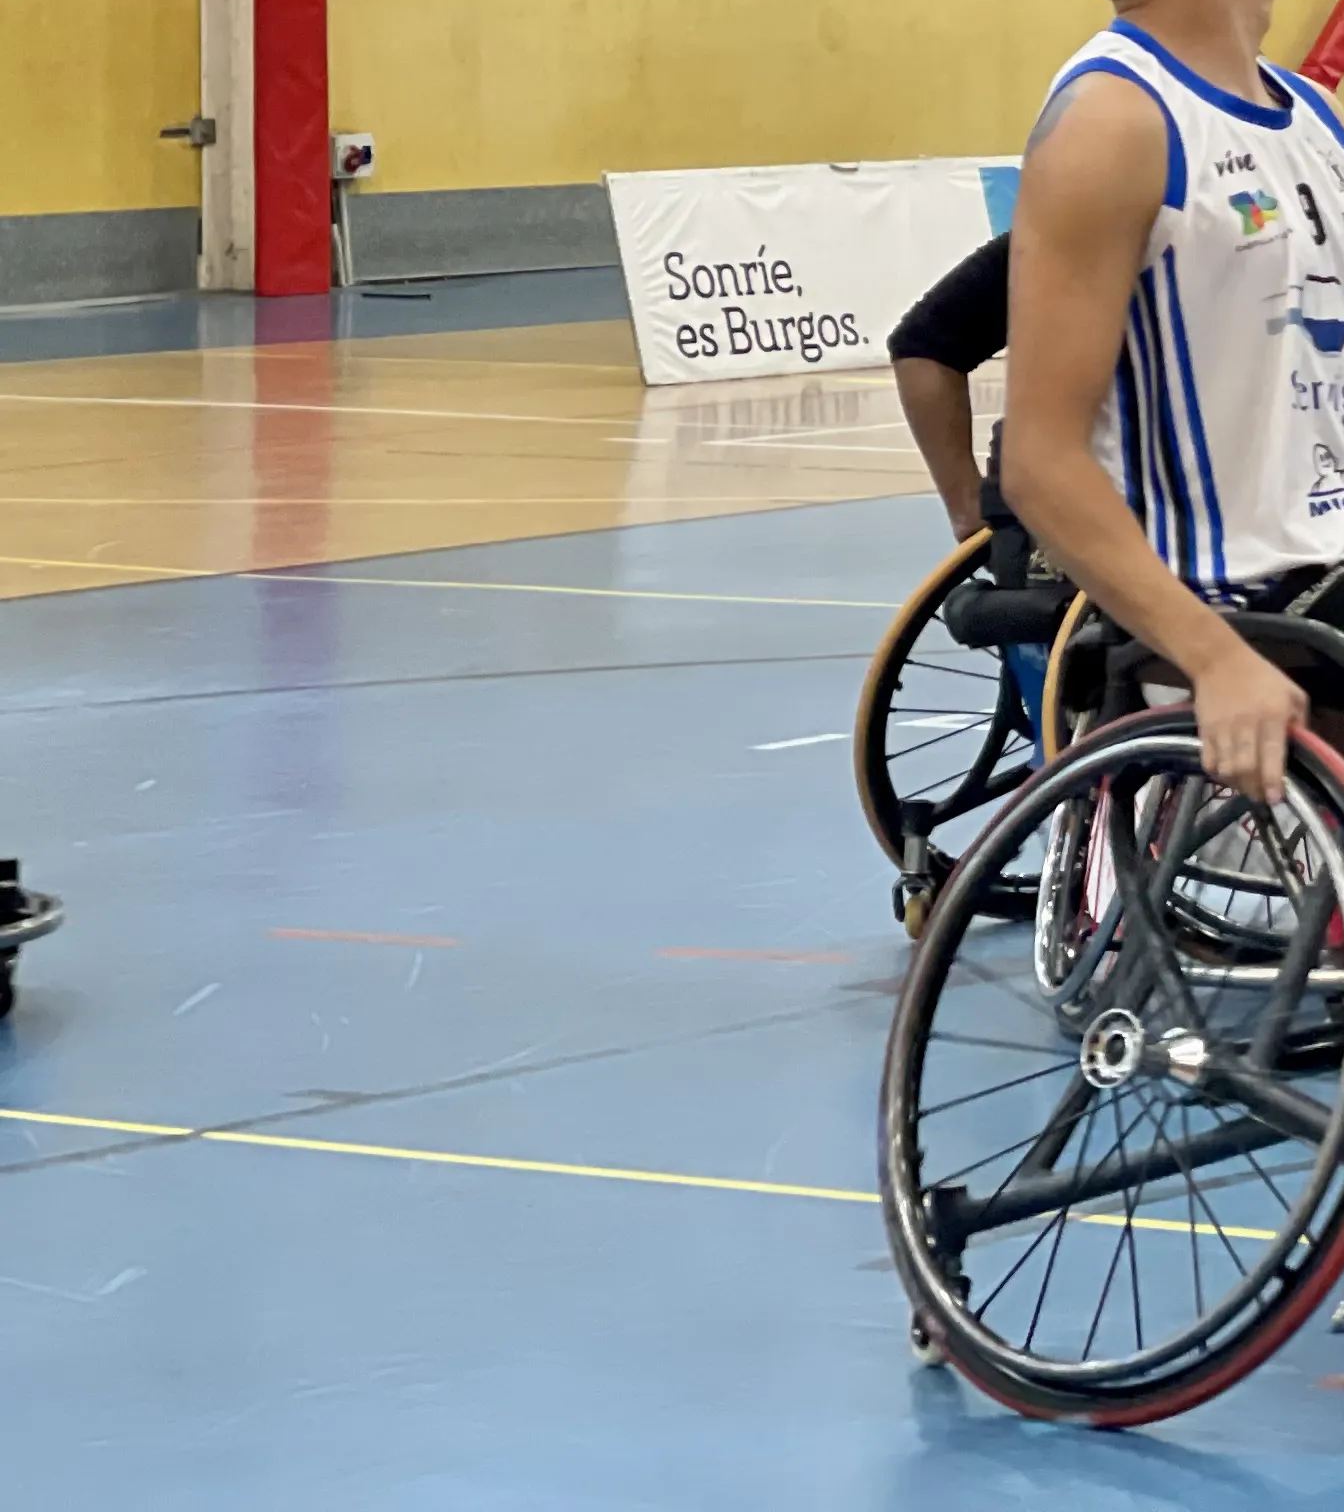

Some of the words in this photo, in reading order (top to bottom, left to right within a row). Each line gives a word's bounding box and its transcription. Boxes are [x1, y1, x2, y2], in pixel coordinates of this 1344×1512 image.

[663, 244, 803, 300] Sonríe,
[676, 320, 719, 359] es
[721, 306, 870, 363] Burgos.
